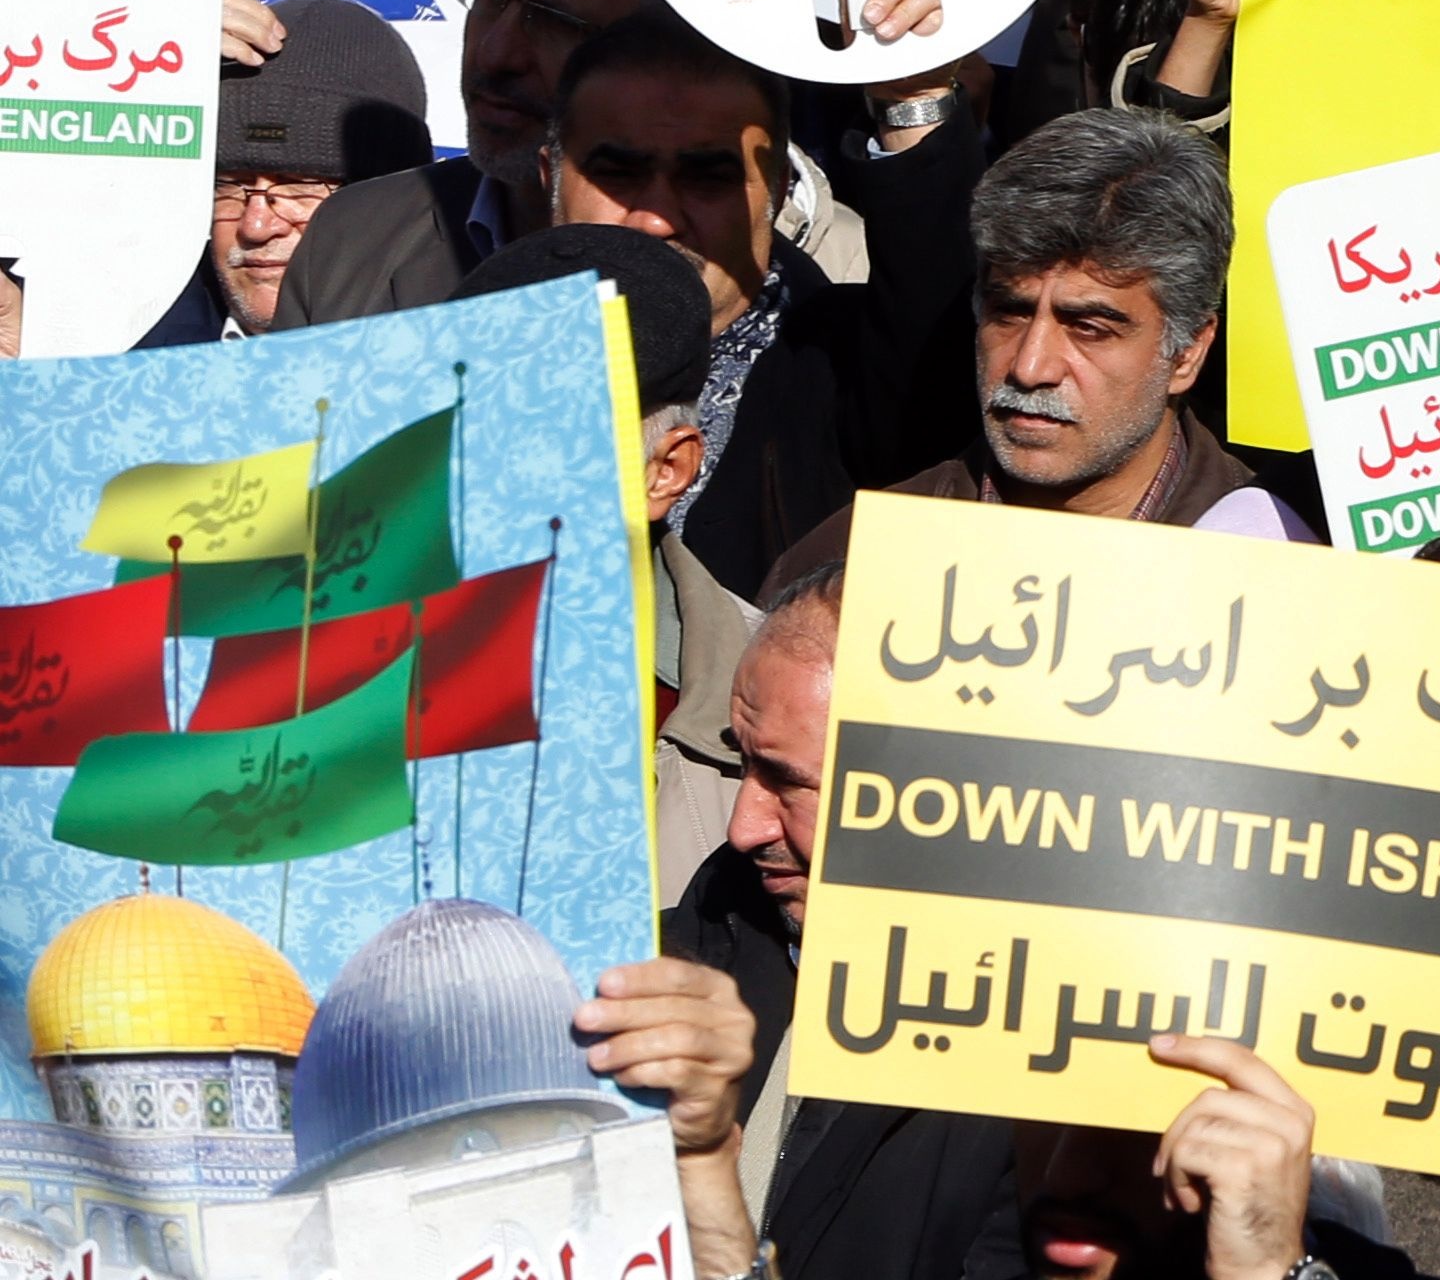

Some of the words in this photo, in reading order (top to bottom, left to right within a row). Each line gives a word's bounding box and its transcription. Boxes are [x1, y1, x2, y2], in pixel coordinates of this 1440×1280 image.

[879, 563, 1244, 716] اسرائیل
[1272, 652, 1371, 749] بر
[840, 771, 1093, 854] DOWN
[1121, 798, 1326, 880] WITH
